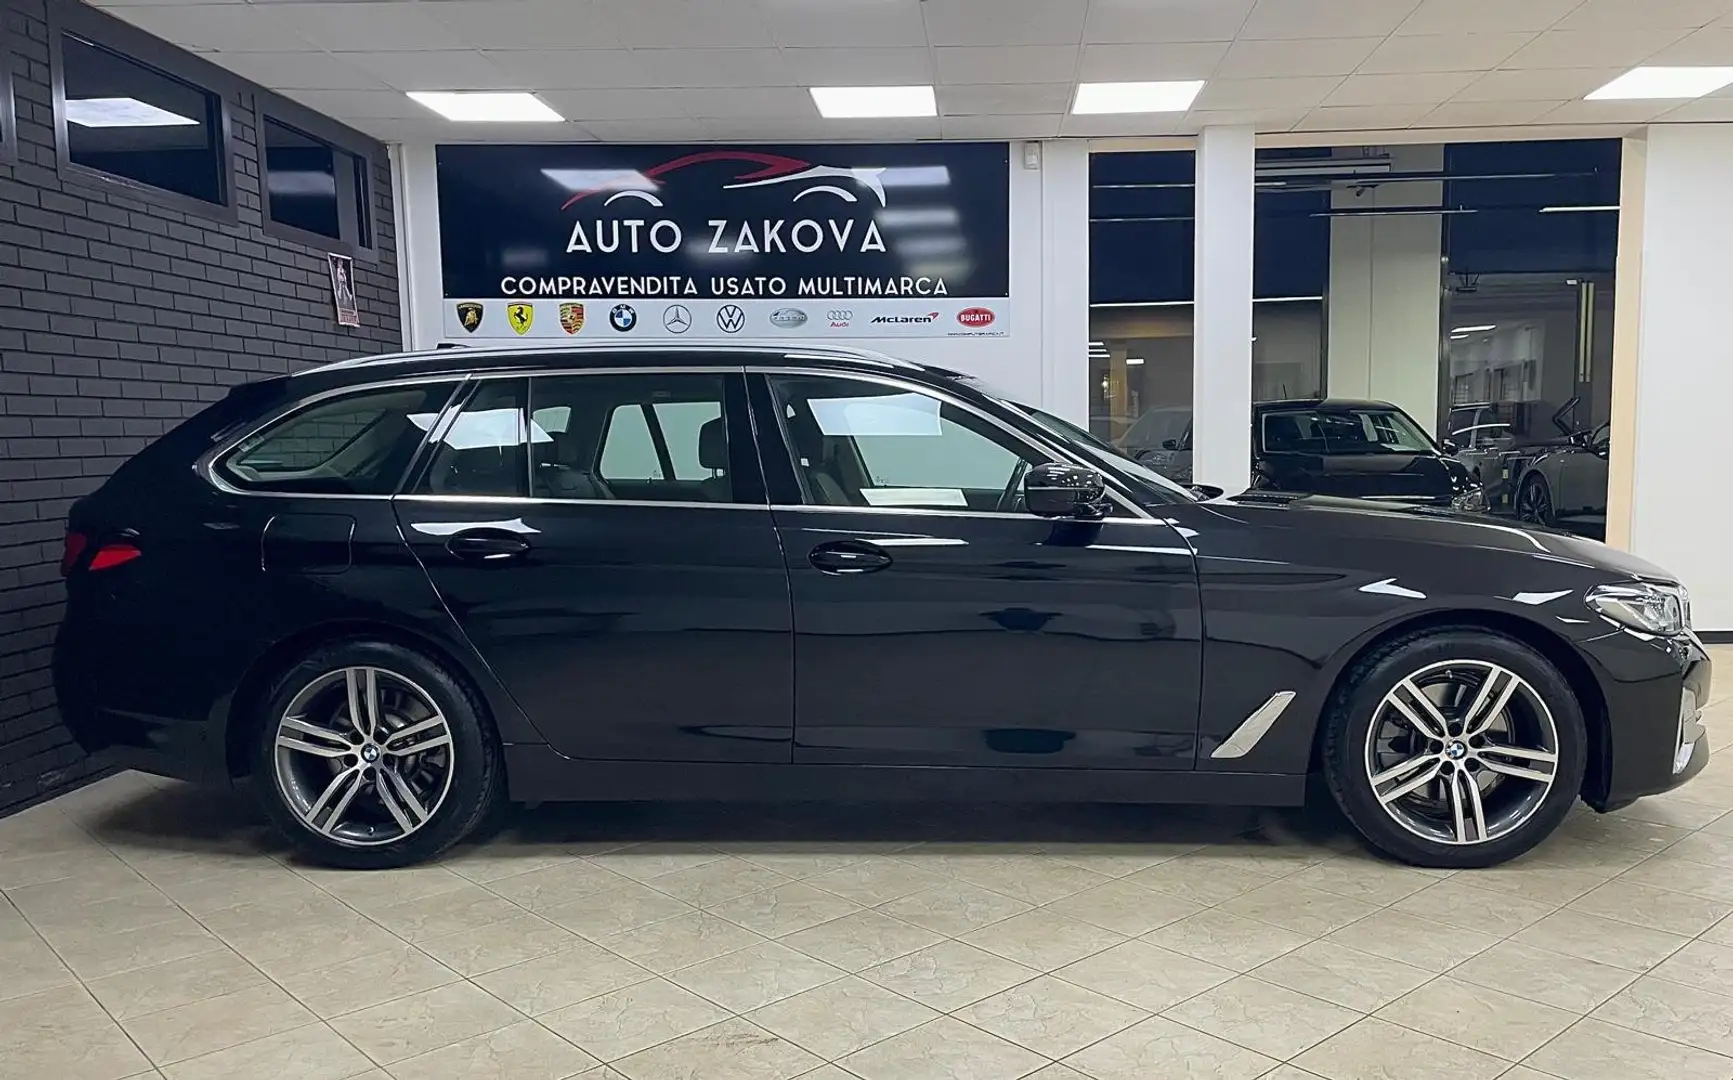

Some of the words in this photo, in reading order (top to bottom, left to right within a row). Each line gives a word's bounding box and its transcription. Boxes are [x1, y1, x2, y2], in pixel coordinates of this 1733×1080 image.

[566, 219, 682, 253] AUTO
[708, 219, 887, 253] ZAKOVA
[500, 276, 698, 295] COMPRAVENDITA
[710, 277, 787, 295] USATO
[798, 276, 949, 295] MULTIMARCA
[870, 316, 932, 324] McLaren
[960, 313, 991, 322] BUGATTI
